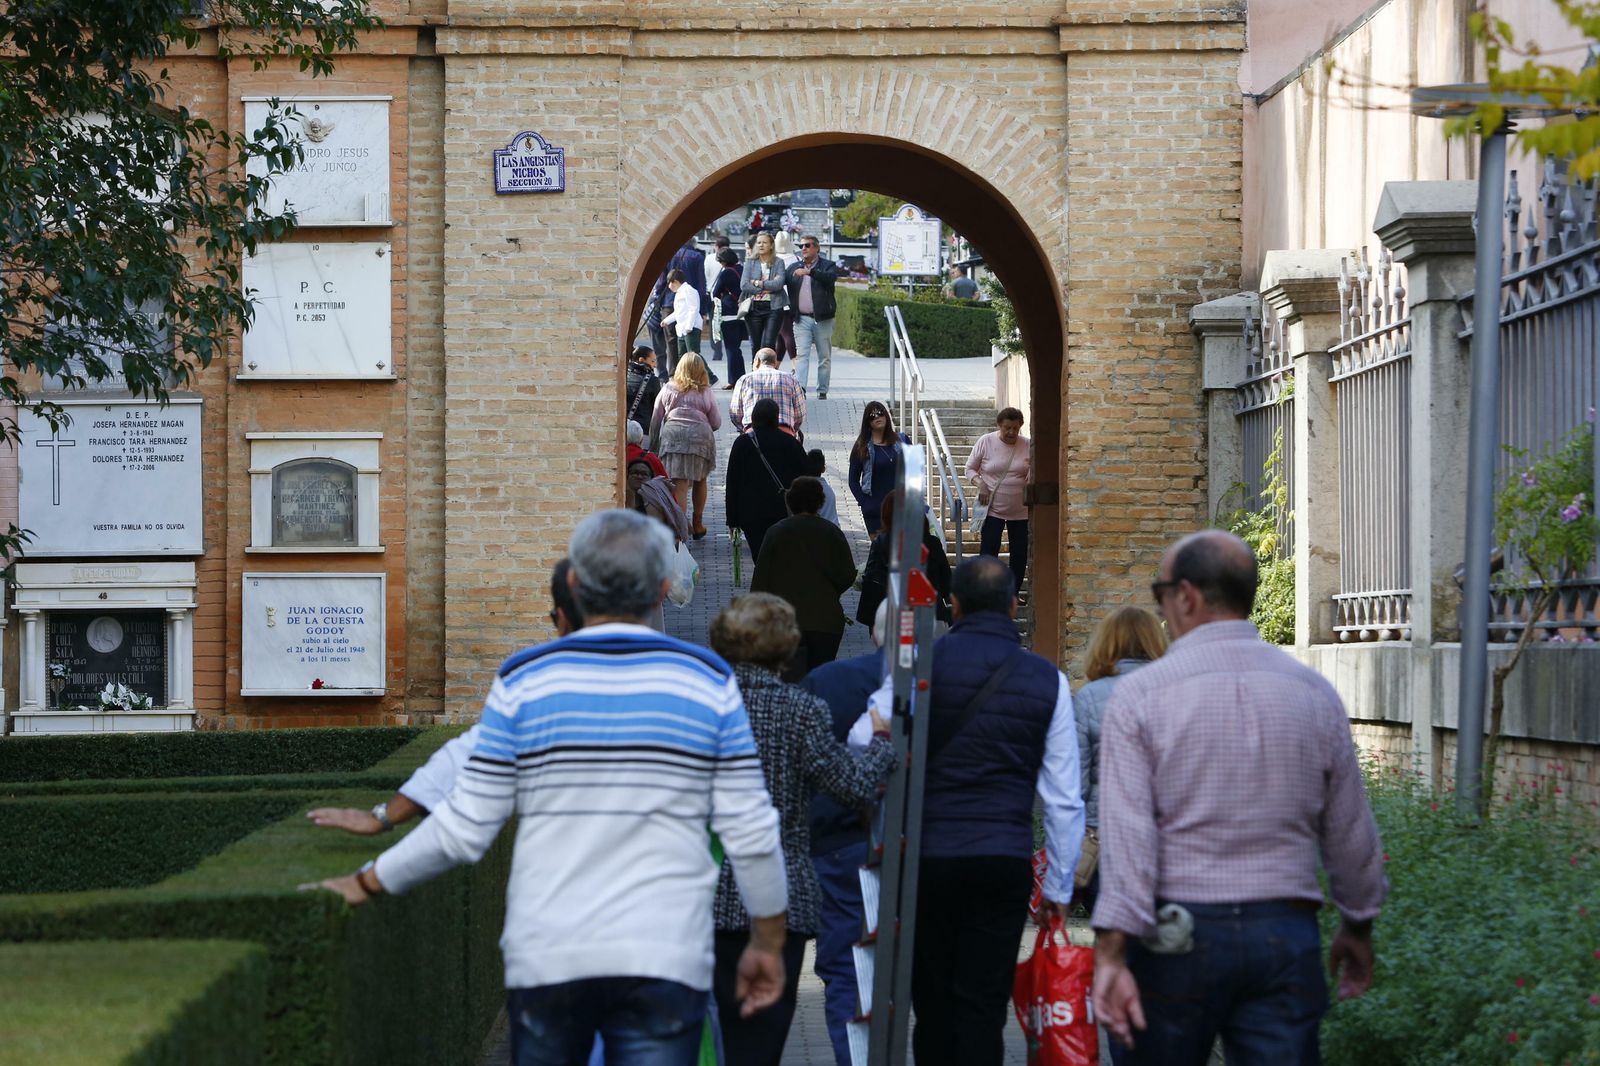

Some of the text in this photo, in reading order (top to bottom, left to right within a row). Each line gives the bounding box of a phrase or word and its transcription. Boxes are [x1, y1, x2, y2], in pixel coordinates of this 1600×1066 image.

[336, 148, 369, 158] JESUS
[501, 155, 559, 168] LAS ANGUSTIAS
[322, 162, 357, 172] JUNCO
[512, 167, 546, 179] NICHOS
[507, 177, 552, 187] SECCION 20
[294, 301, 346, 310] A PERPETUIDAD
[92, 420, 184, 429] JOSEFA HERNANDEZ MAGAN
[88, 438, 126, 446] FRANCISCO
[149, 437, 188, 445] HERNANDEZ
[92, 454, 185, 463] DOLORES TARA HERNANDEZ
[288, 606, 364, 615] JUAN IGNACIO
[287, 616, 365, 625] DE LA CUESTA
[306, 627, 345, 635] GODOY
